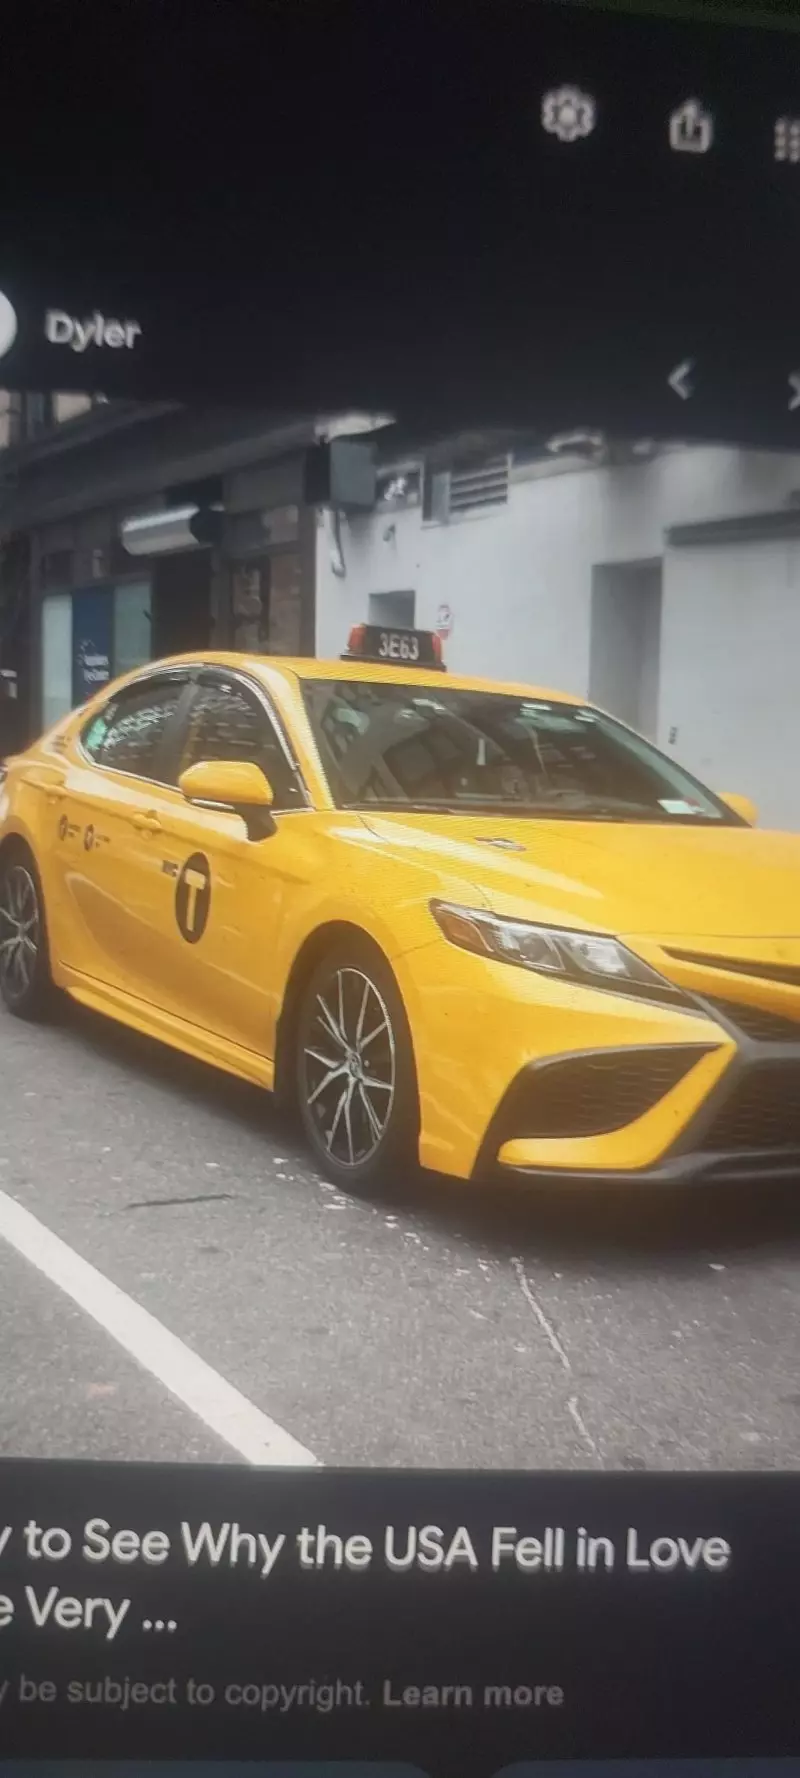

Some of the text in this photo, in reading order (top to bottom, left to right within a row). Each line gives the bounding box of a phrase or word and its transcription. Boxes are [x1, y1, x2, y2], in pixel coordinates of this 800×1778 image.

[46, 309, 142, 352] Dyler
[379, 633, 419, 660] 3E63
[24, 1520, 72, 1560] to
[82, 1518, 171, 1564] See
[181, 1521, 286, 1579] Why
[297, 1525, 373, 1567] the
[385, 1525, 479, 1571] USA
[491, 1526, 566, 1570] Fell
[576, 1526, 615, 1570] in
[626, 1527, 731, 1571] Love
[25, 1585, 131, 1640] Very
[19, 1673, 57, 1702] be
[66, 1675, 177, 1710] subject
[186, 1678, 215, 1705] to
[224, 1679, 370, 1712] copyright.
[383, 1679, 473, 1707] Learn
[483, 1684, 565, 1707] more
